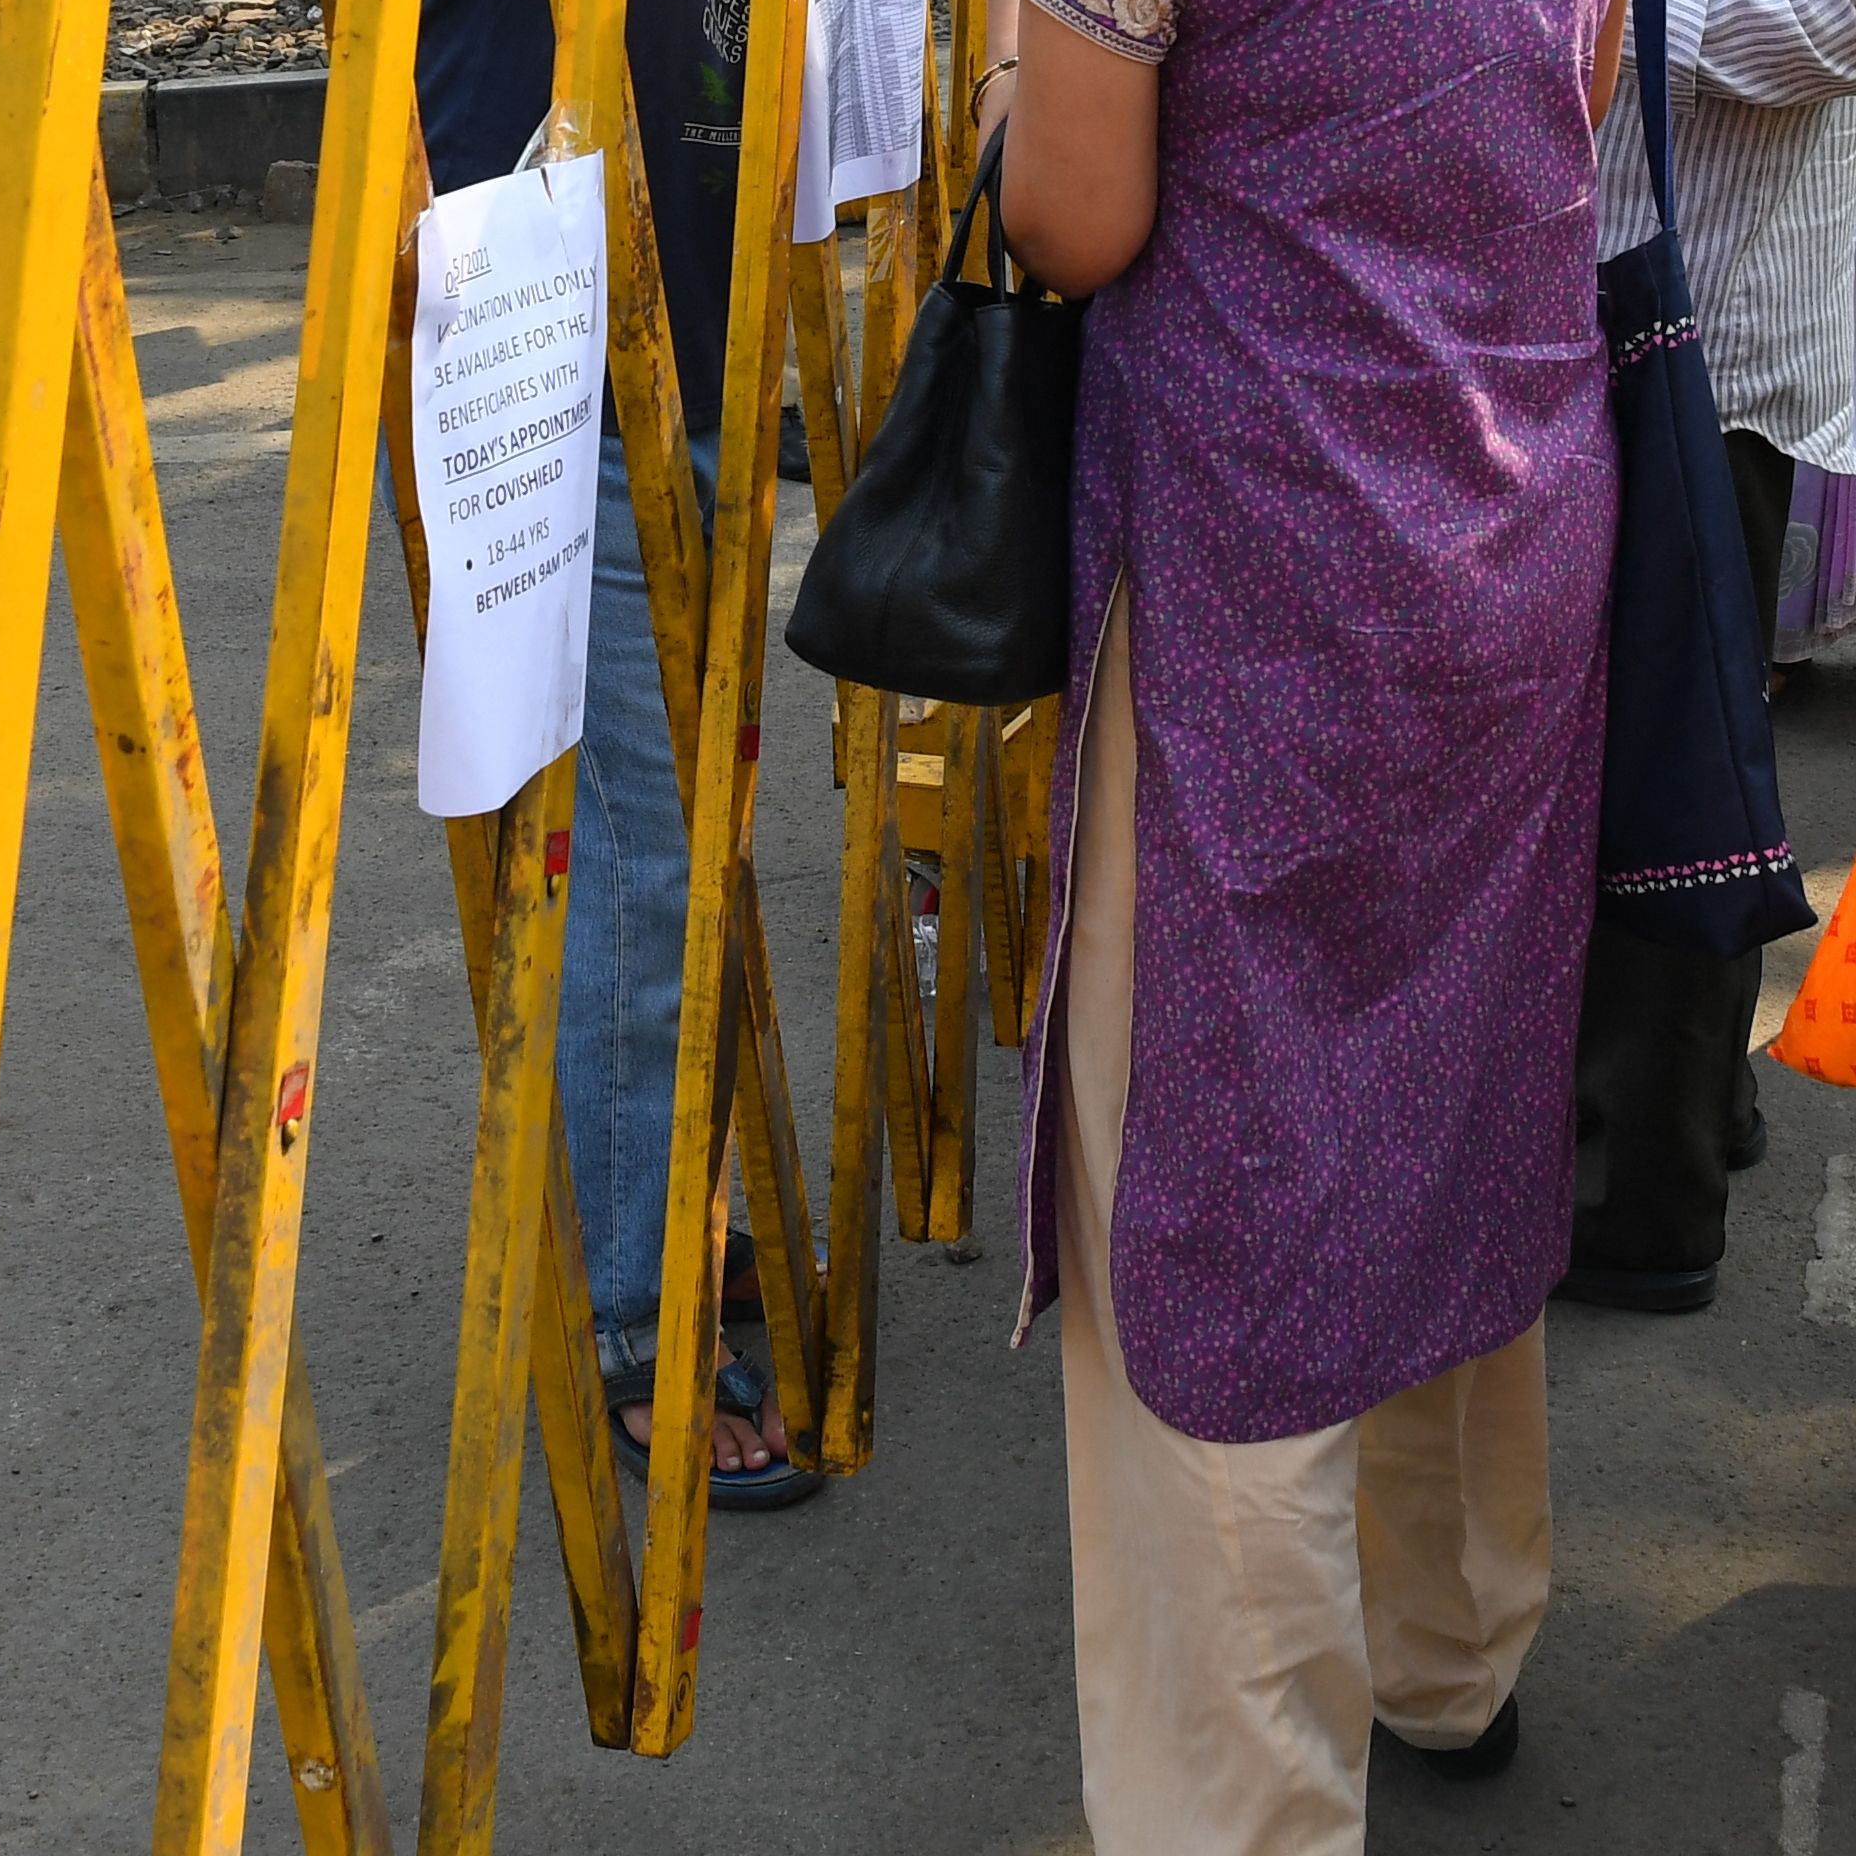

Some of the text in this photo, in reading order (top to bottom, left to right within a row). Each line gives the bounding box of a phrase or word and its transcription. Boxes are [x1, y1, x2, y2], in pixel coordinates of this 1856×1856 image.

[513, 279, 553, 309] WILL
[553, 264, 598, 298] ONLY
[457, 335, 522, 381] AVAILABLE
[524, 323, 557, 354] FOR
[557, 312, 589, 342] THE
[438, 360, 580, 435] BENEFICIARIES WITH
[442, 391, 593, 479] TODAY'S APPOINTMENT
[449, 457, 564, 526] FOR COVISHIELD
[476, 527, 590, 615] BETWEEN 9AM TO 5PM
[487, 516, 551, 567] 18-44 YRS
